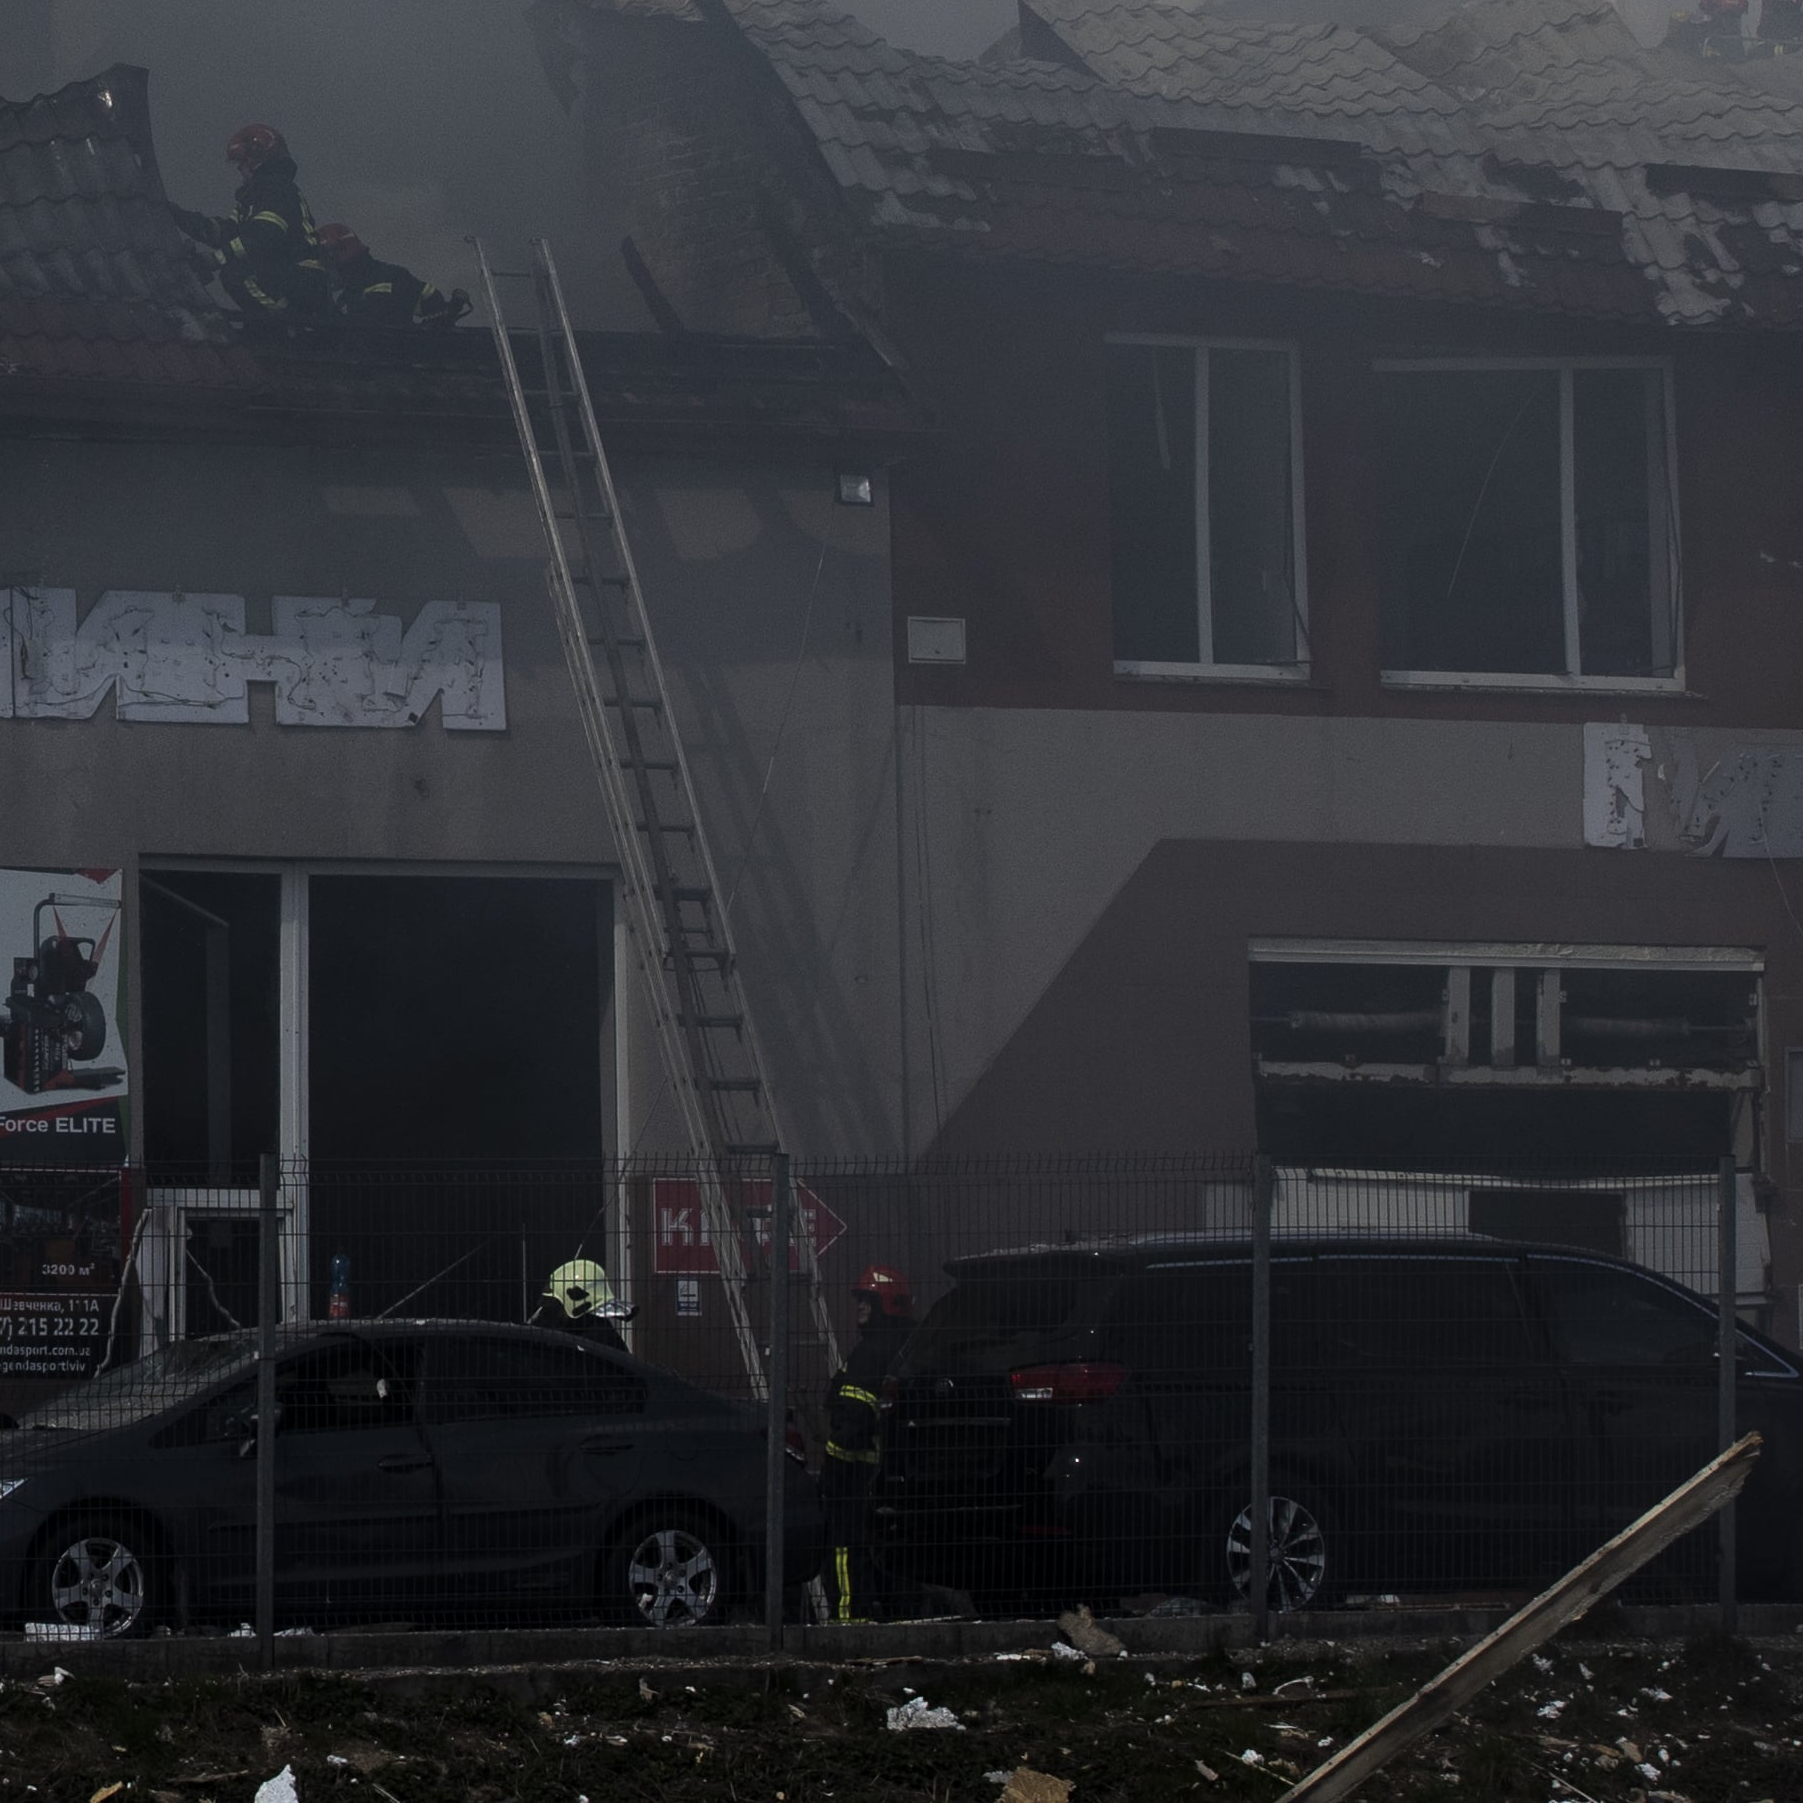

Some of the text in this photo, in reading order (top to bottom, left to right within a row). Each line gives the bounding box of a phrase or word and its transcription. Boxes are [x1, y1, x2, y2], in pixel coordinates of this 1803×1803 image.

[55, 1117, 115, 1134] ELITE
[42, 1264, 75, 1276] 3200
[0, 1299, 65, 1314] Шевченка,
[17, 1318, 47, 1336] 215
[54, 1318, 74, 1336] 22
[79, 1318, 99, 1336] 22
